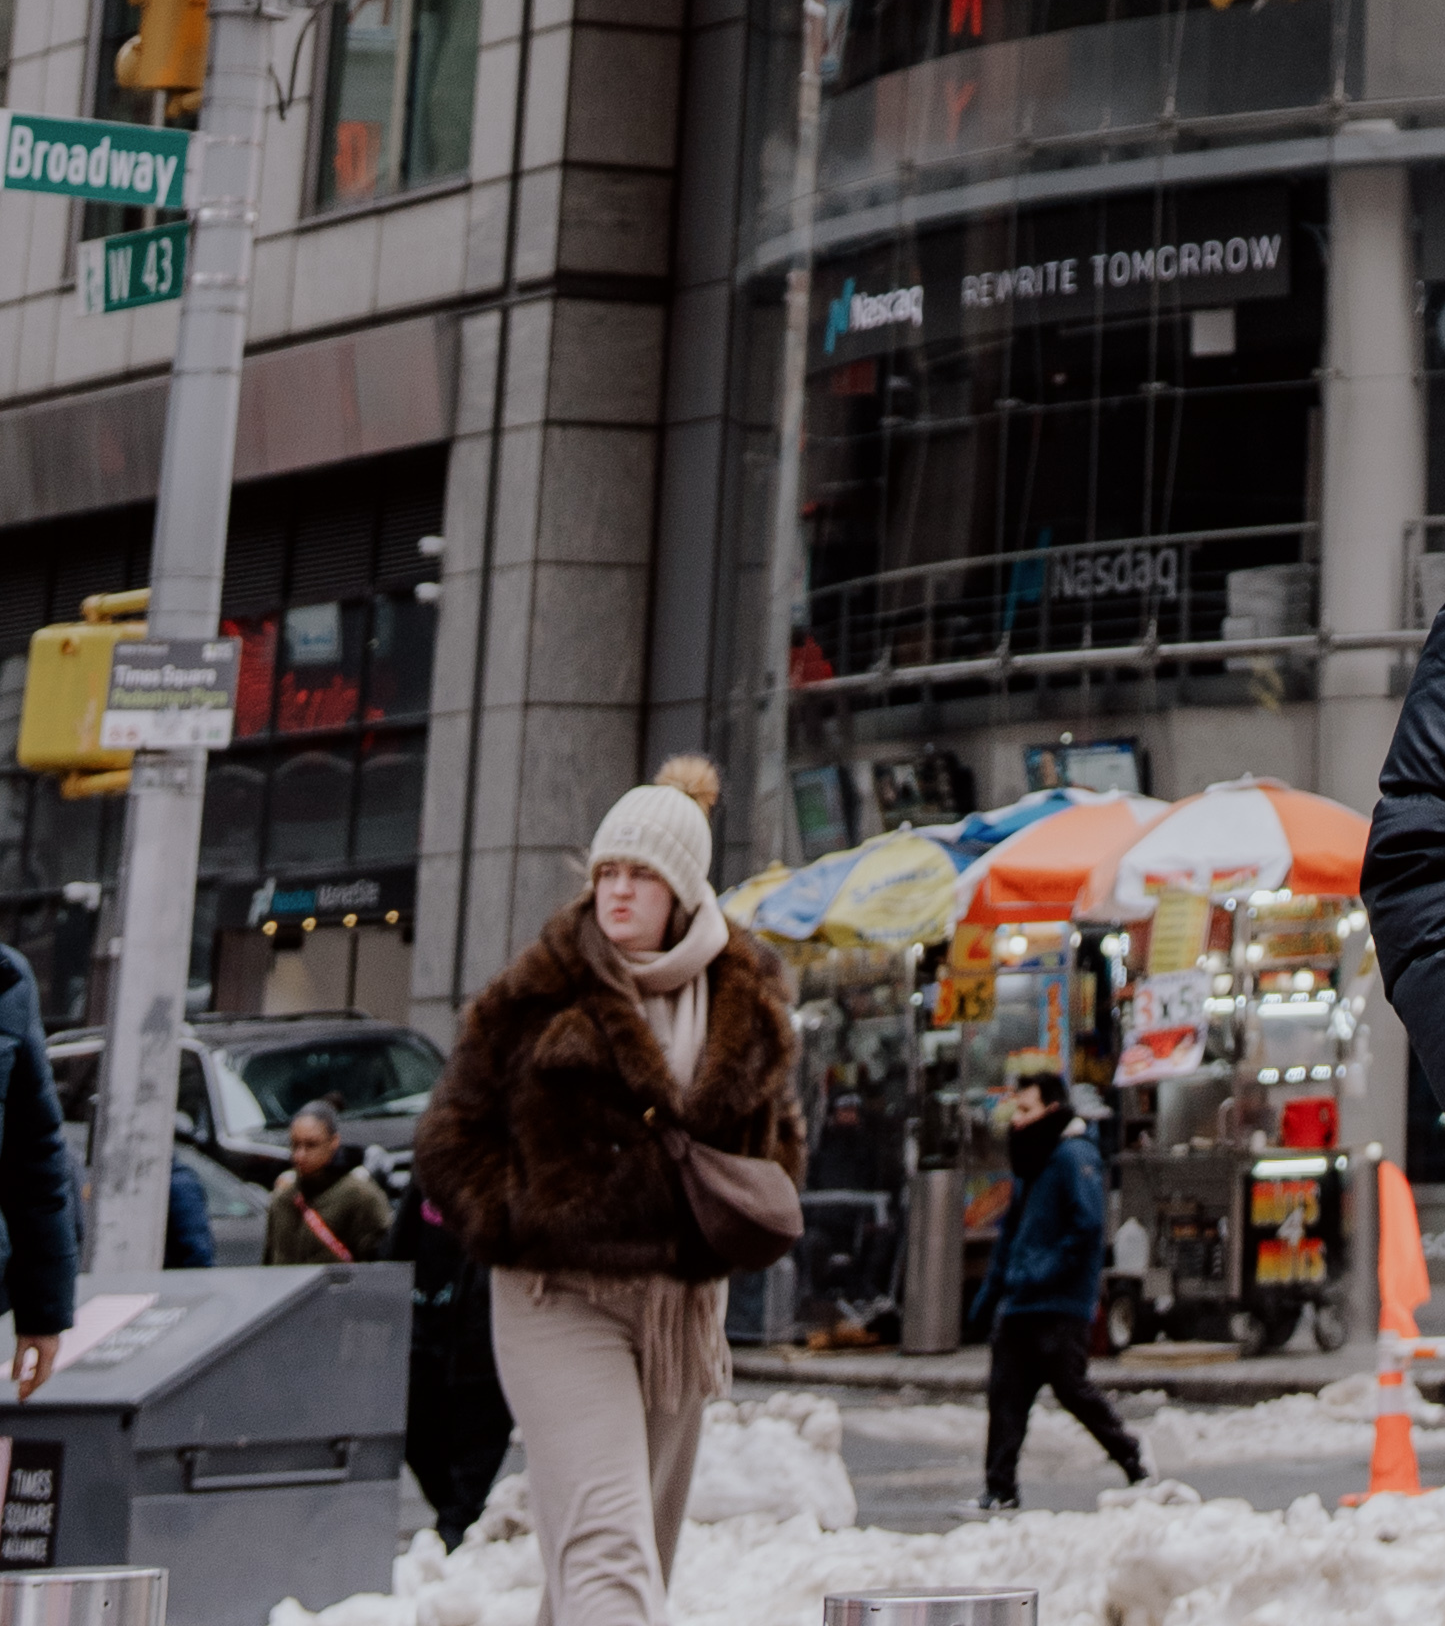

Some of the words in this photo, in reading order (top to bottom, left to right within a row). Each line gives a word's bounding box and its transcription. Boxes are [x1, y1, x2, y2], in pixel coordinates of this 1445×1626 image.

[8, 125, 178, 206] Broadway
[109, 244, 133, 302] W
[141, 237, 174, 294] 43
[849, 285, 924, 329] Nasdaq
[961, 257, 1078, 309] REWRITE
[1091, 233, 1282, 287] TOMORROW
[1052, 549, 1178, 600] Nasdaq
[114, 664, 161, 688] Times
[162, 665, 217, 689] Square
[11, 1468, 54, 1500] TIMES
[4, 1501, 55, 1535] SQUARE
